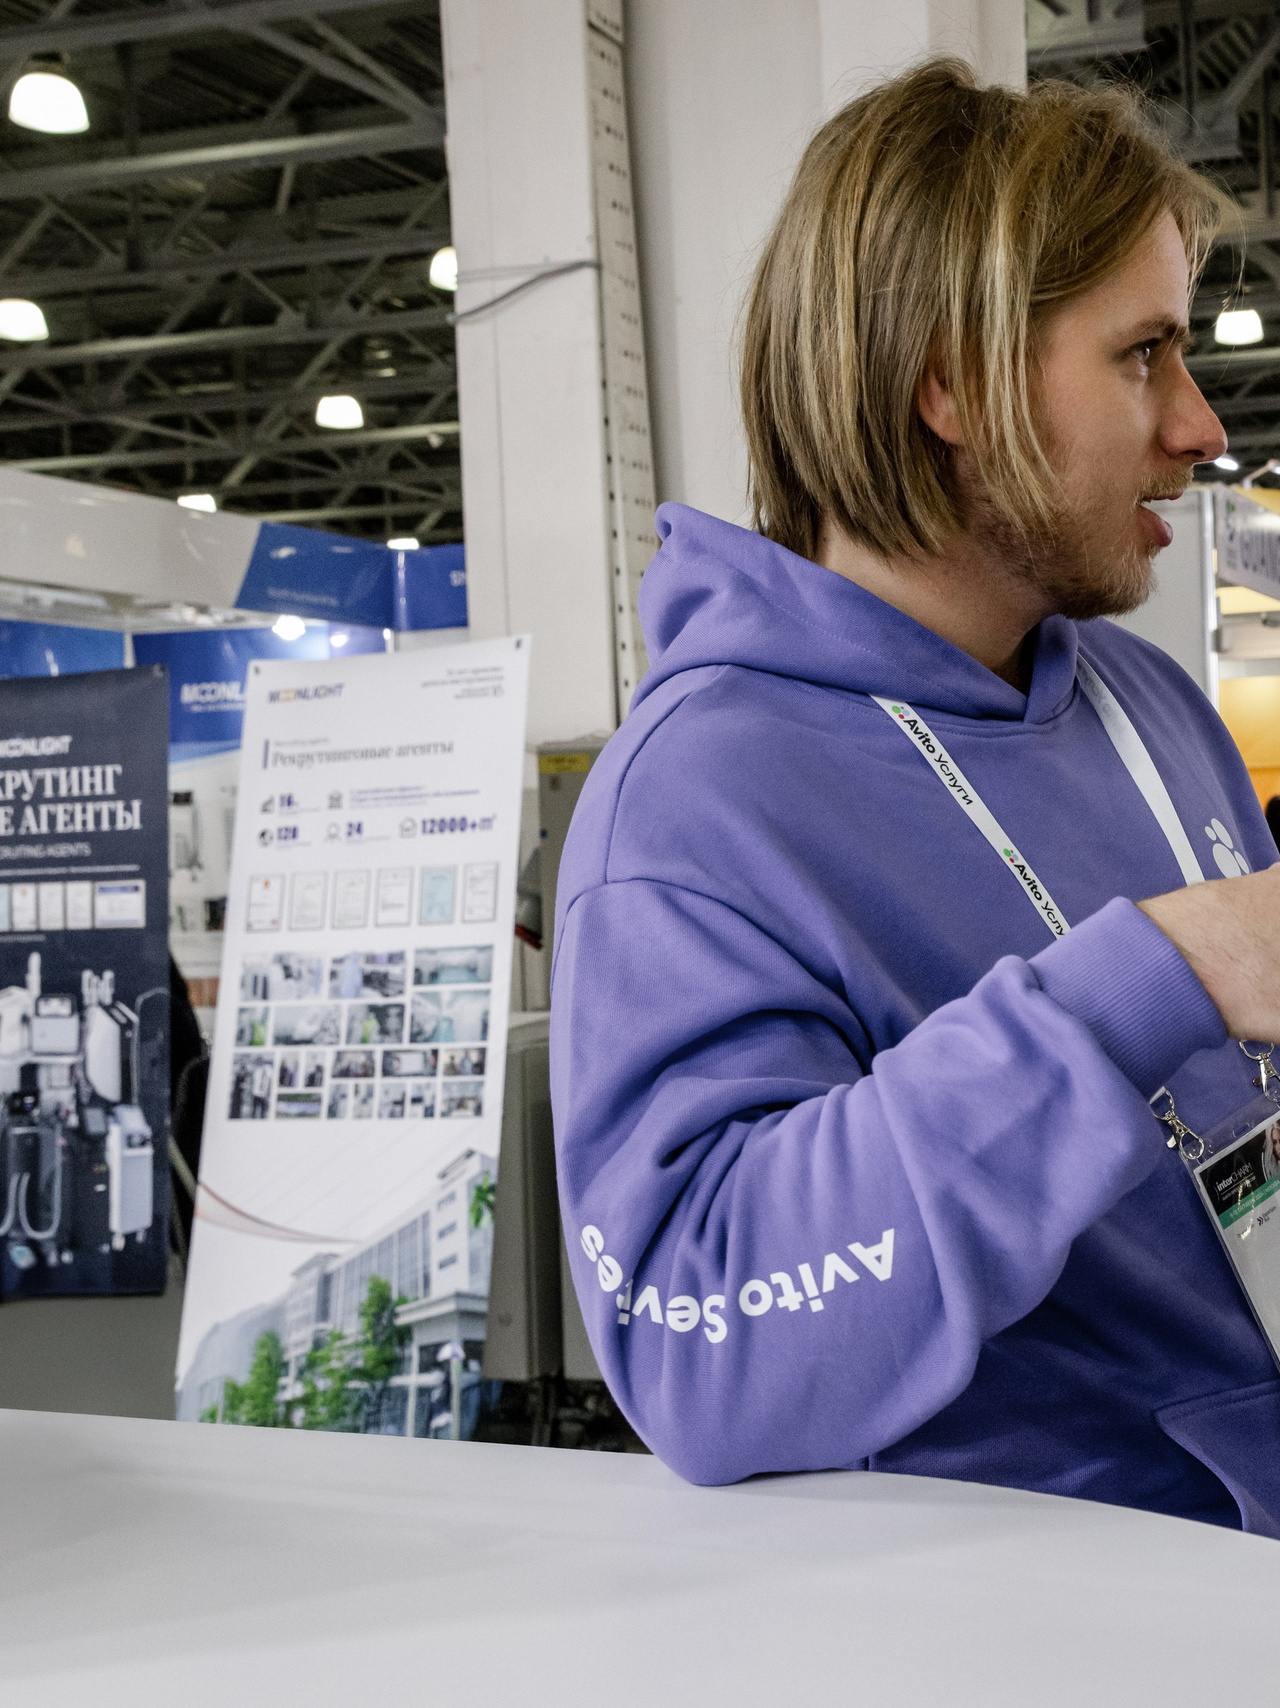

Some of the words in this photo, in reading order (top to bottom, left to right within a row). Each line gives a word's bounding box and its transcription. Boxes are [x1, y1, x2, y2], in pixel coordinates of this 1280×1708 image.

[903, 719, 936, 754] Avito
[934, 753, 974, 806] Услуги
[0, 764, 123, 801] РУТИНГ
[18, 799, 143, 836] АГЕНТЫ
[1014, 863, 1042, 901] Avito
[1216, 1162, 1253, 1192] interCHARM
[739, 1228, 895, 1317] Avito
